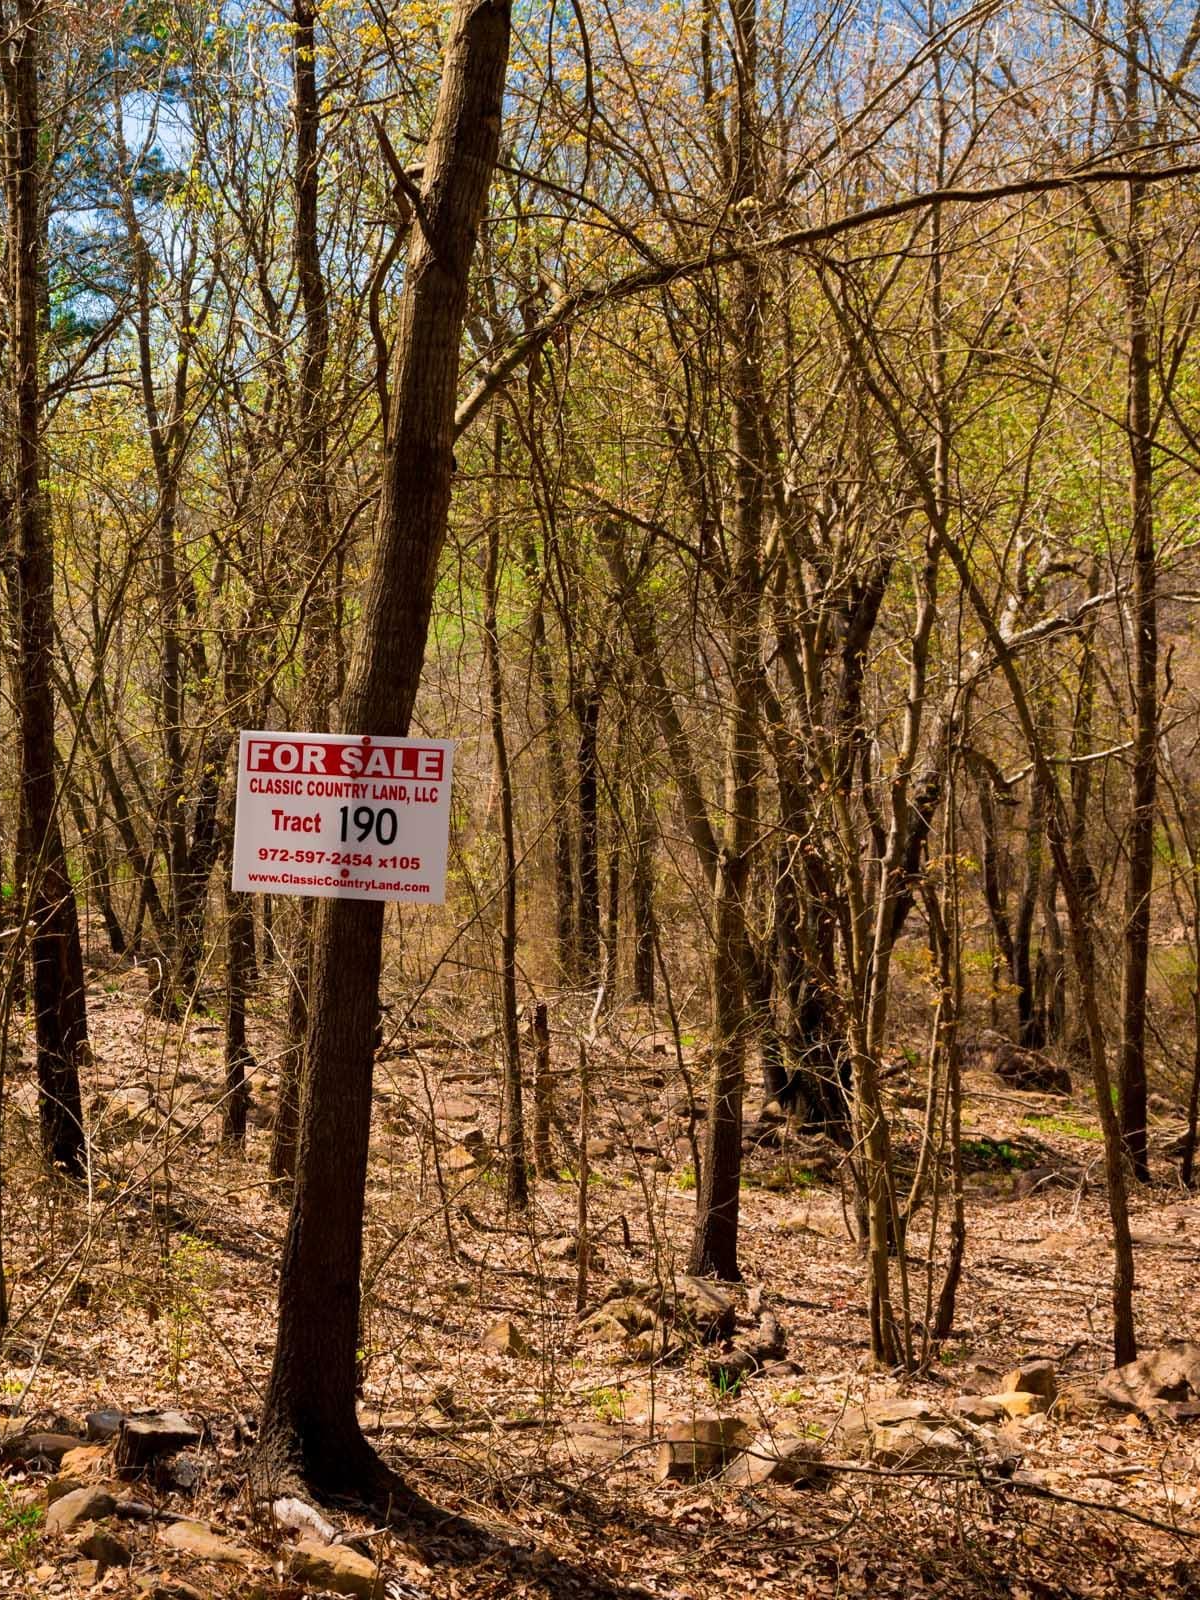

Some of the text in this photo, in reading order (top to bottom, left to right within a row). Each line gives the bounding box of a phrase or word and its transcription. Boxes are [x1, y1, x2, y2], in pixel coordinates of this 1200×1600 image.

[250, 742, 440, 778] FOR SALE
[250, 778, 438, 804] CLASSIC COUNTRY LAND, LLC
[272, 806, 398, 845] Tract 190
[258, 848, 420, 870] 972-597-2454 x105
[248, 872, 430, 893] www.ClassicCountryLand.com
